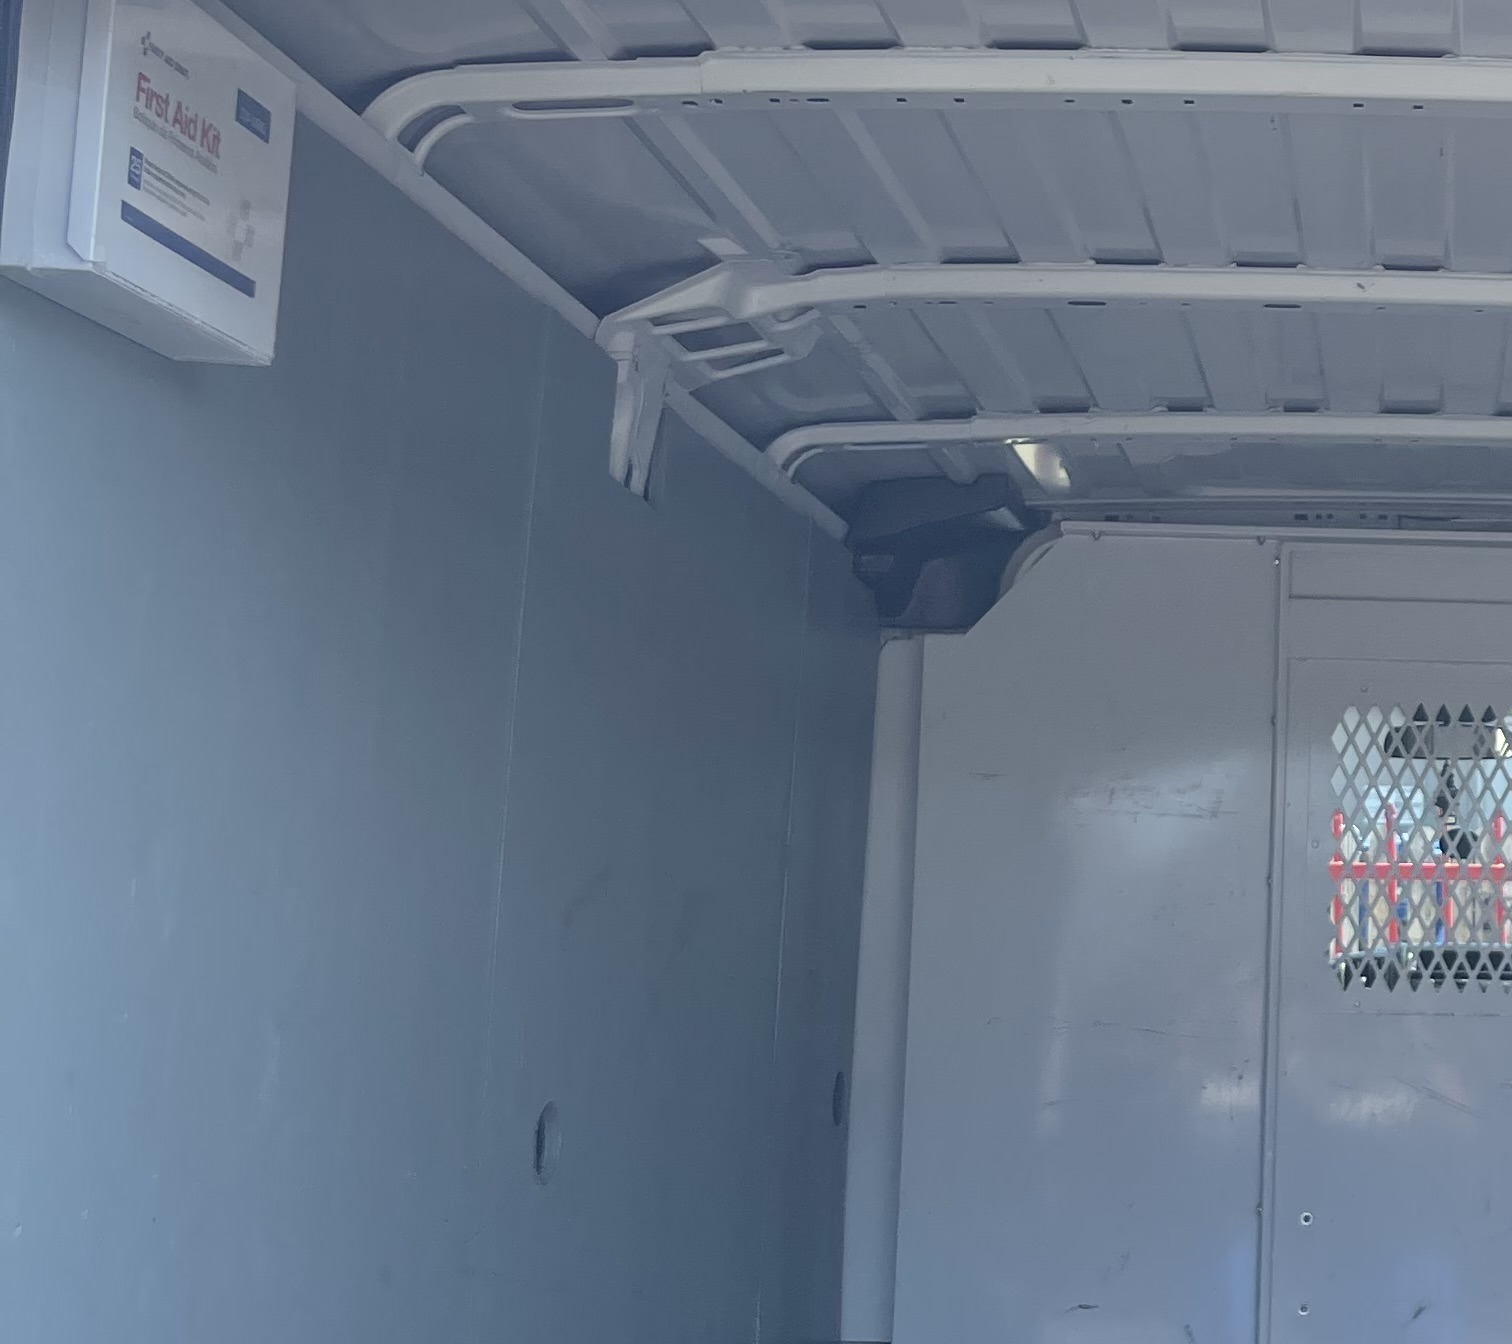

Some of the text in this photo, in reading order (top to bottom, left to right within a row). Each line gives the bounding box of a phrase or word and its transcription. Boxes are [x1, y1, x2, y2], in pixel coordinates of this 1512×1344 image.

[136, 71, 170, 124] First
[172, 101, 199, 142] Aid
[200, 117, 222, 160] Kit
[130, 154, 142, 175] 25
